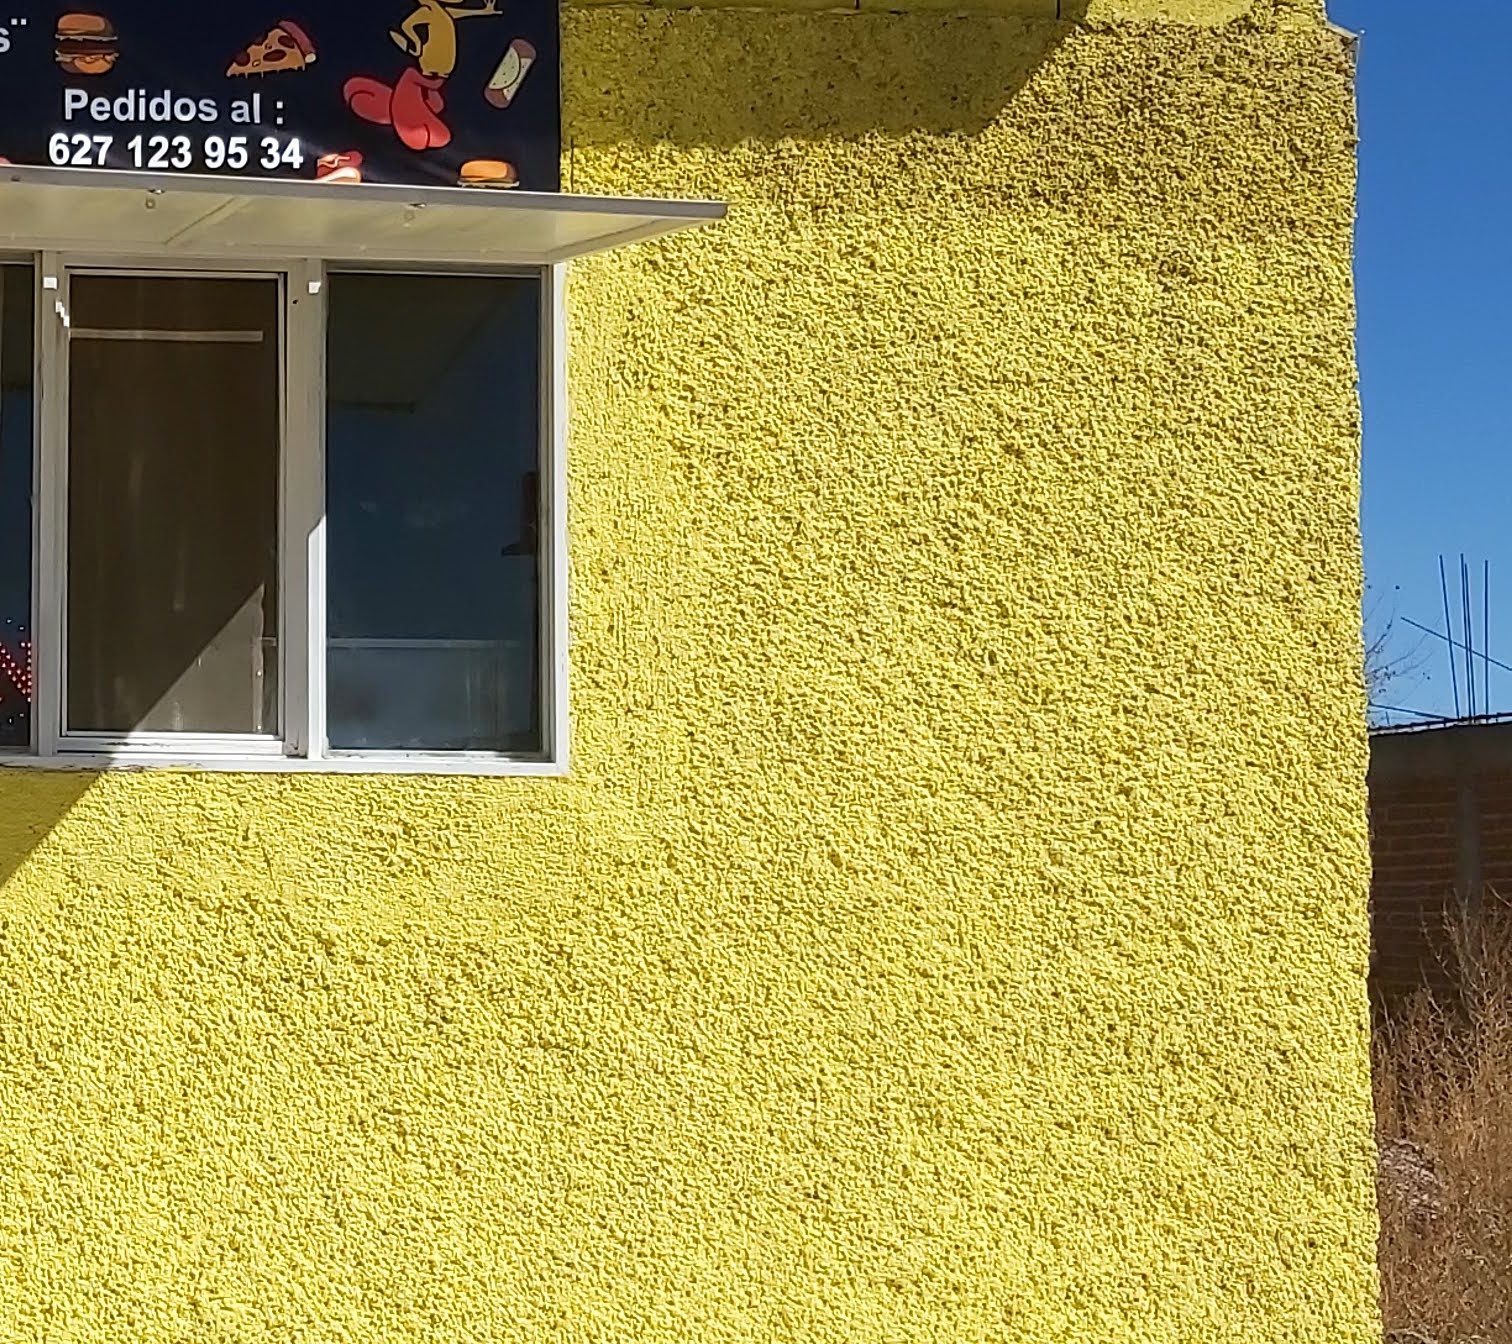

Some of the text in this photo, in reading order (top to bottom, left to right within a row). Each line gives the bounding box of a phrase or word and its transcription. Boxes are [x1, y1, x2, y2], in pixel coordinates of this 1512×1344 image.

[64, 88, 218, 123] Pedidos
[48, 131, 304, 170] 627 123 95 34
